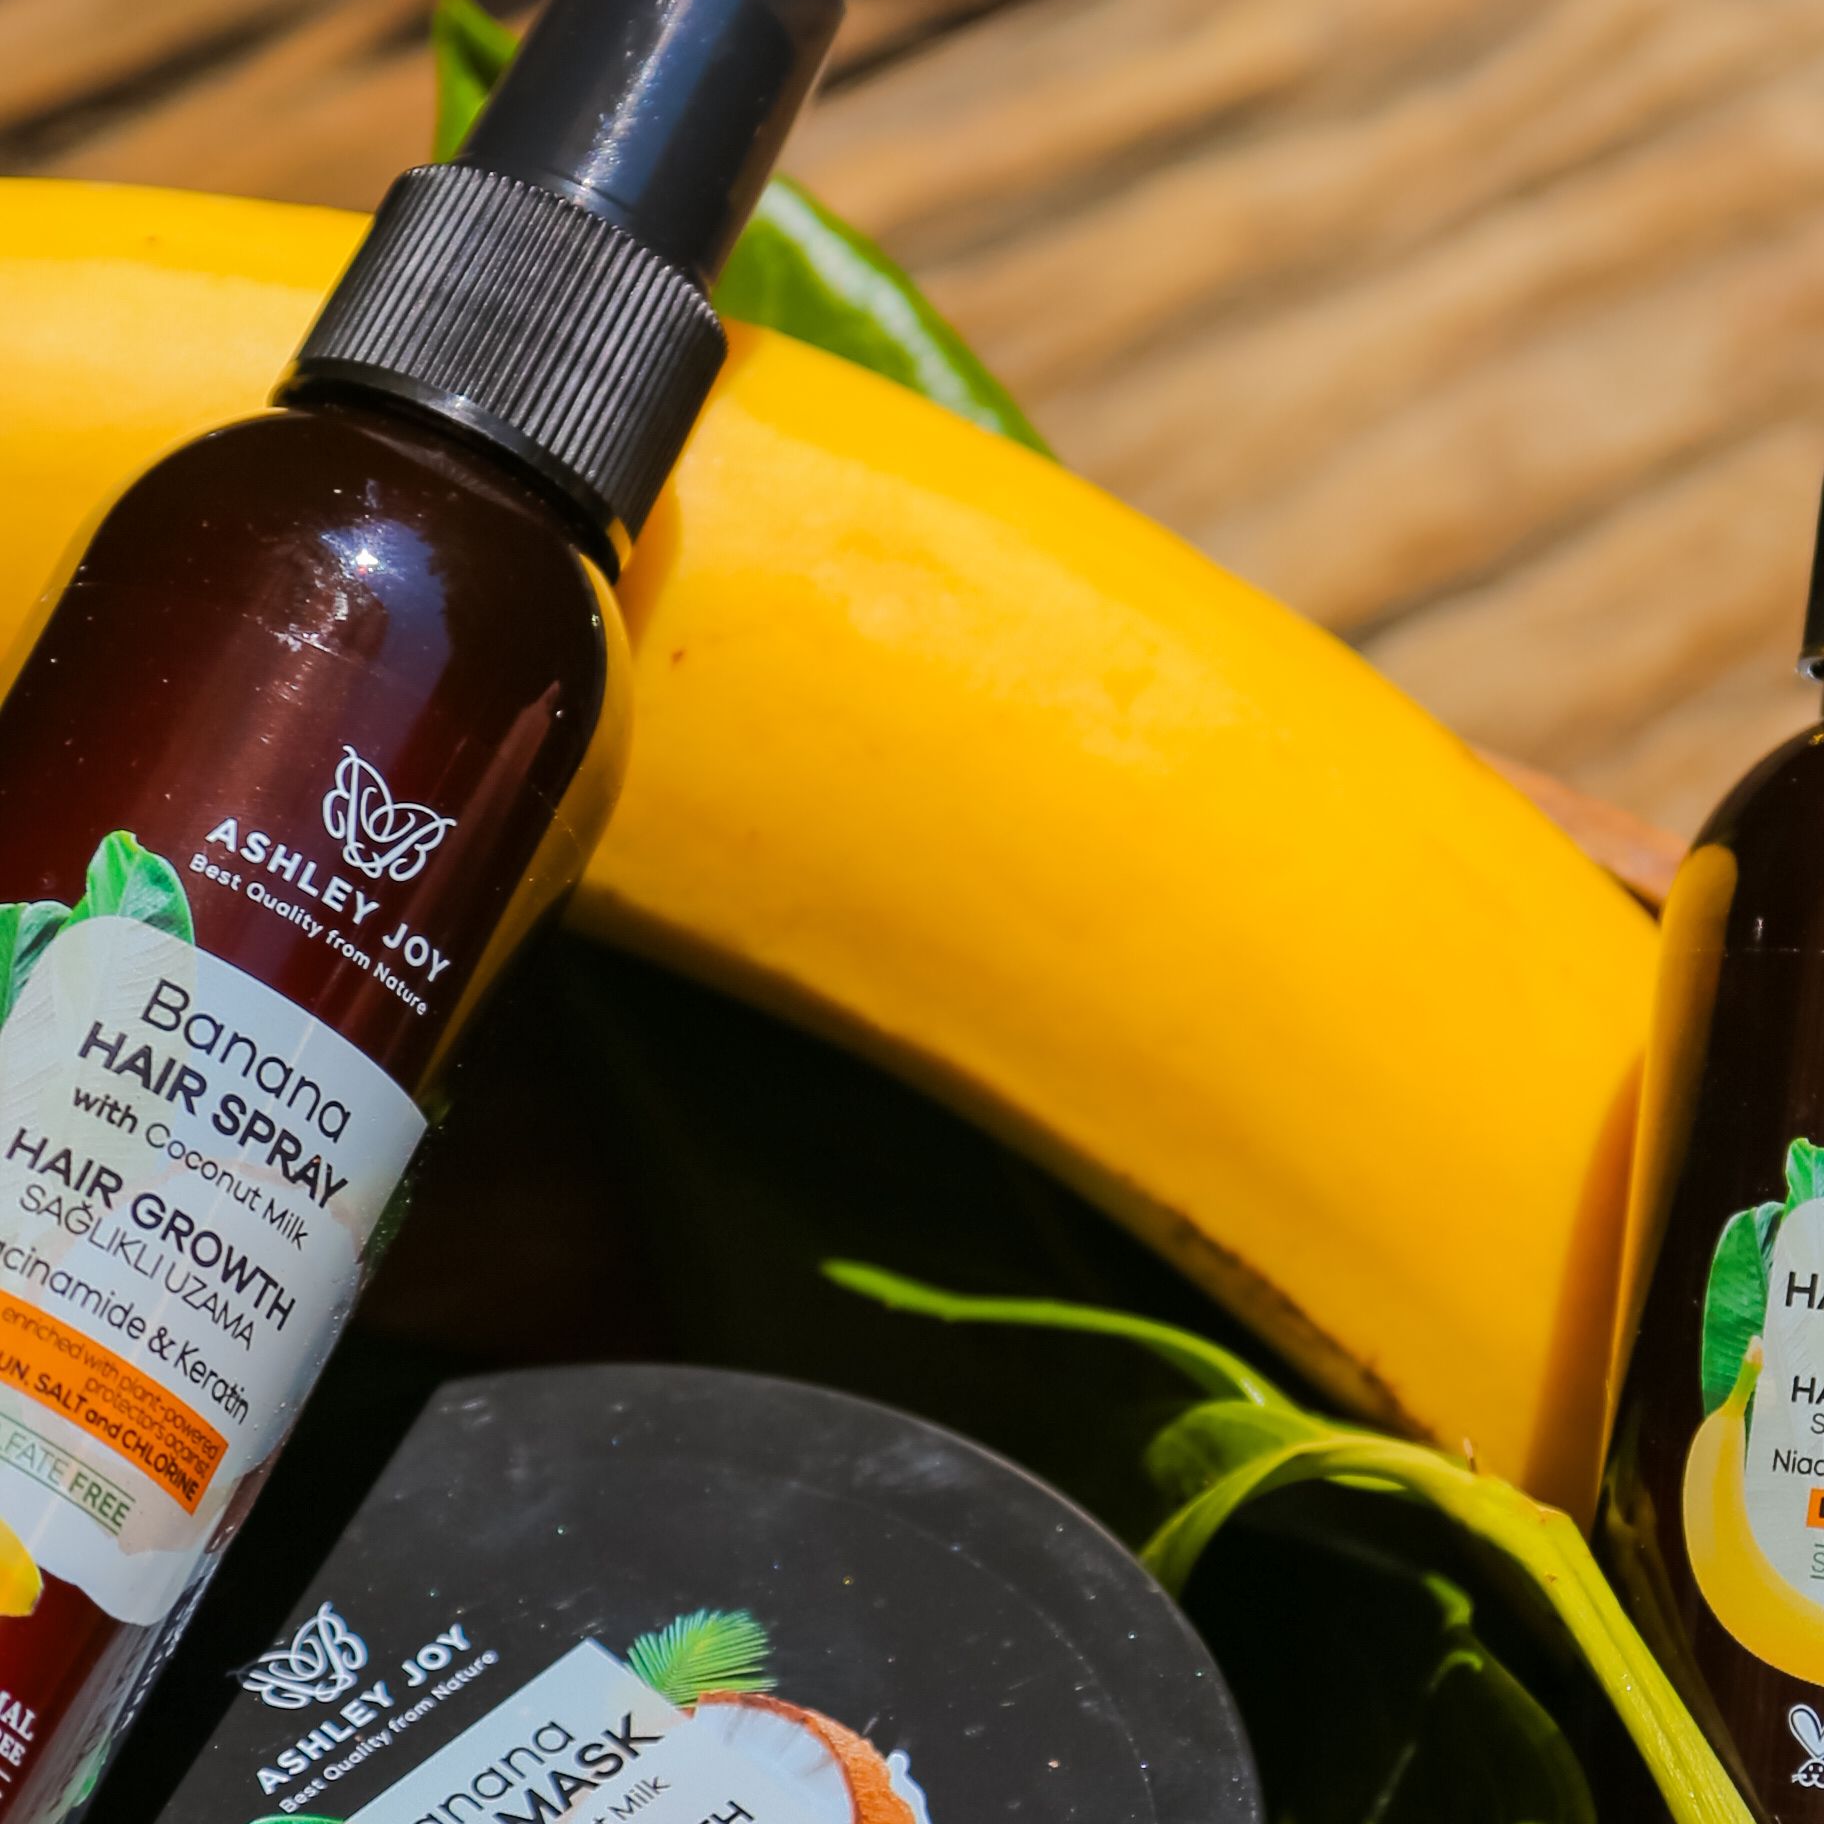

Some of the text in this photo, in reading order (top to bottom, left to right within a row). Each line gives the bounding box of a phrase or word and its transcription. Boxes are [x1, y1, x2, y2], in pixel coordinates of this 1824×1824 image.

[189, 852, 429, 1017] Best Quality from Nature
[205, 817, 451, 984] ASHLEY JOY
[78, 1021, 348, 1209] HAIR SPRAY
[140, 978, 353, 1143] Banana
[5, 1127, 296, 1331] HAIR GROWTH
[73, 1085, 309, 1251] with Coconut Milk
[0, 1241, 249, 1425] cinamide & Keratin
[2, 1306, 85, 1359] enriched
[84, 1351, 119, 1380] with
[20, 1184, 255, 1351] SAĞLIKLI UZAMA
[34, 1372, 87, 1414] SALT
[85, 1409, 122, 1440] and
[121, 1429, 199, 1502] CHLORINE
[84, 1377, 165, 1441] protectors
[68, 1472, 131, 1528] FREE
[256, 1623, 472, 1796] ASHLEY JOY
[278, 1649, 501, 1815] Best Quality from Nature
[608, 1775, 673, 1822] Milk
